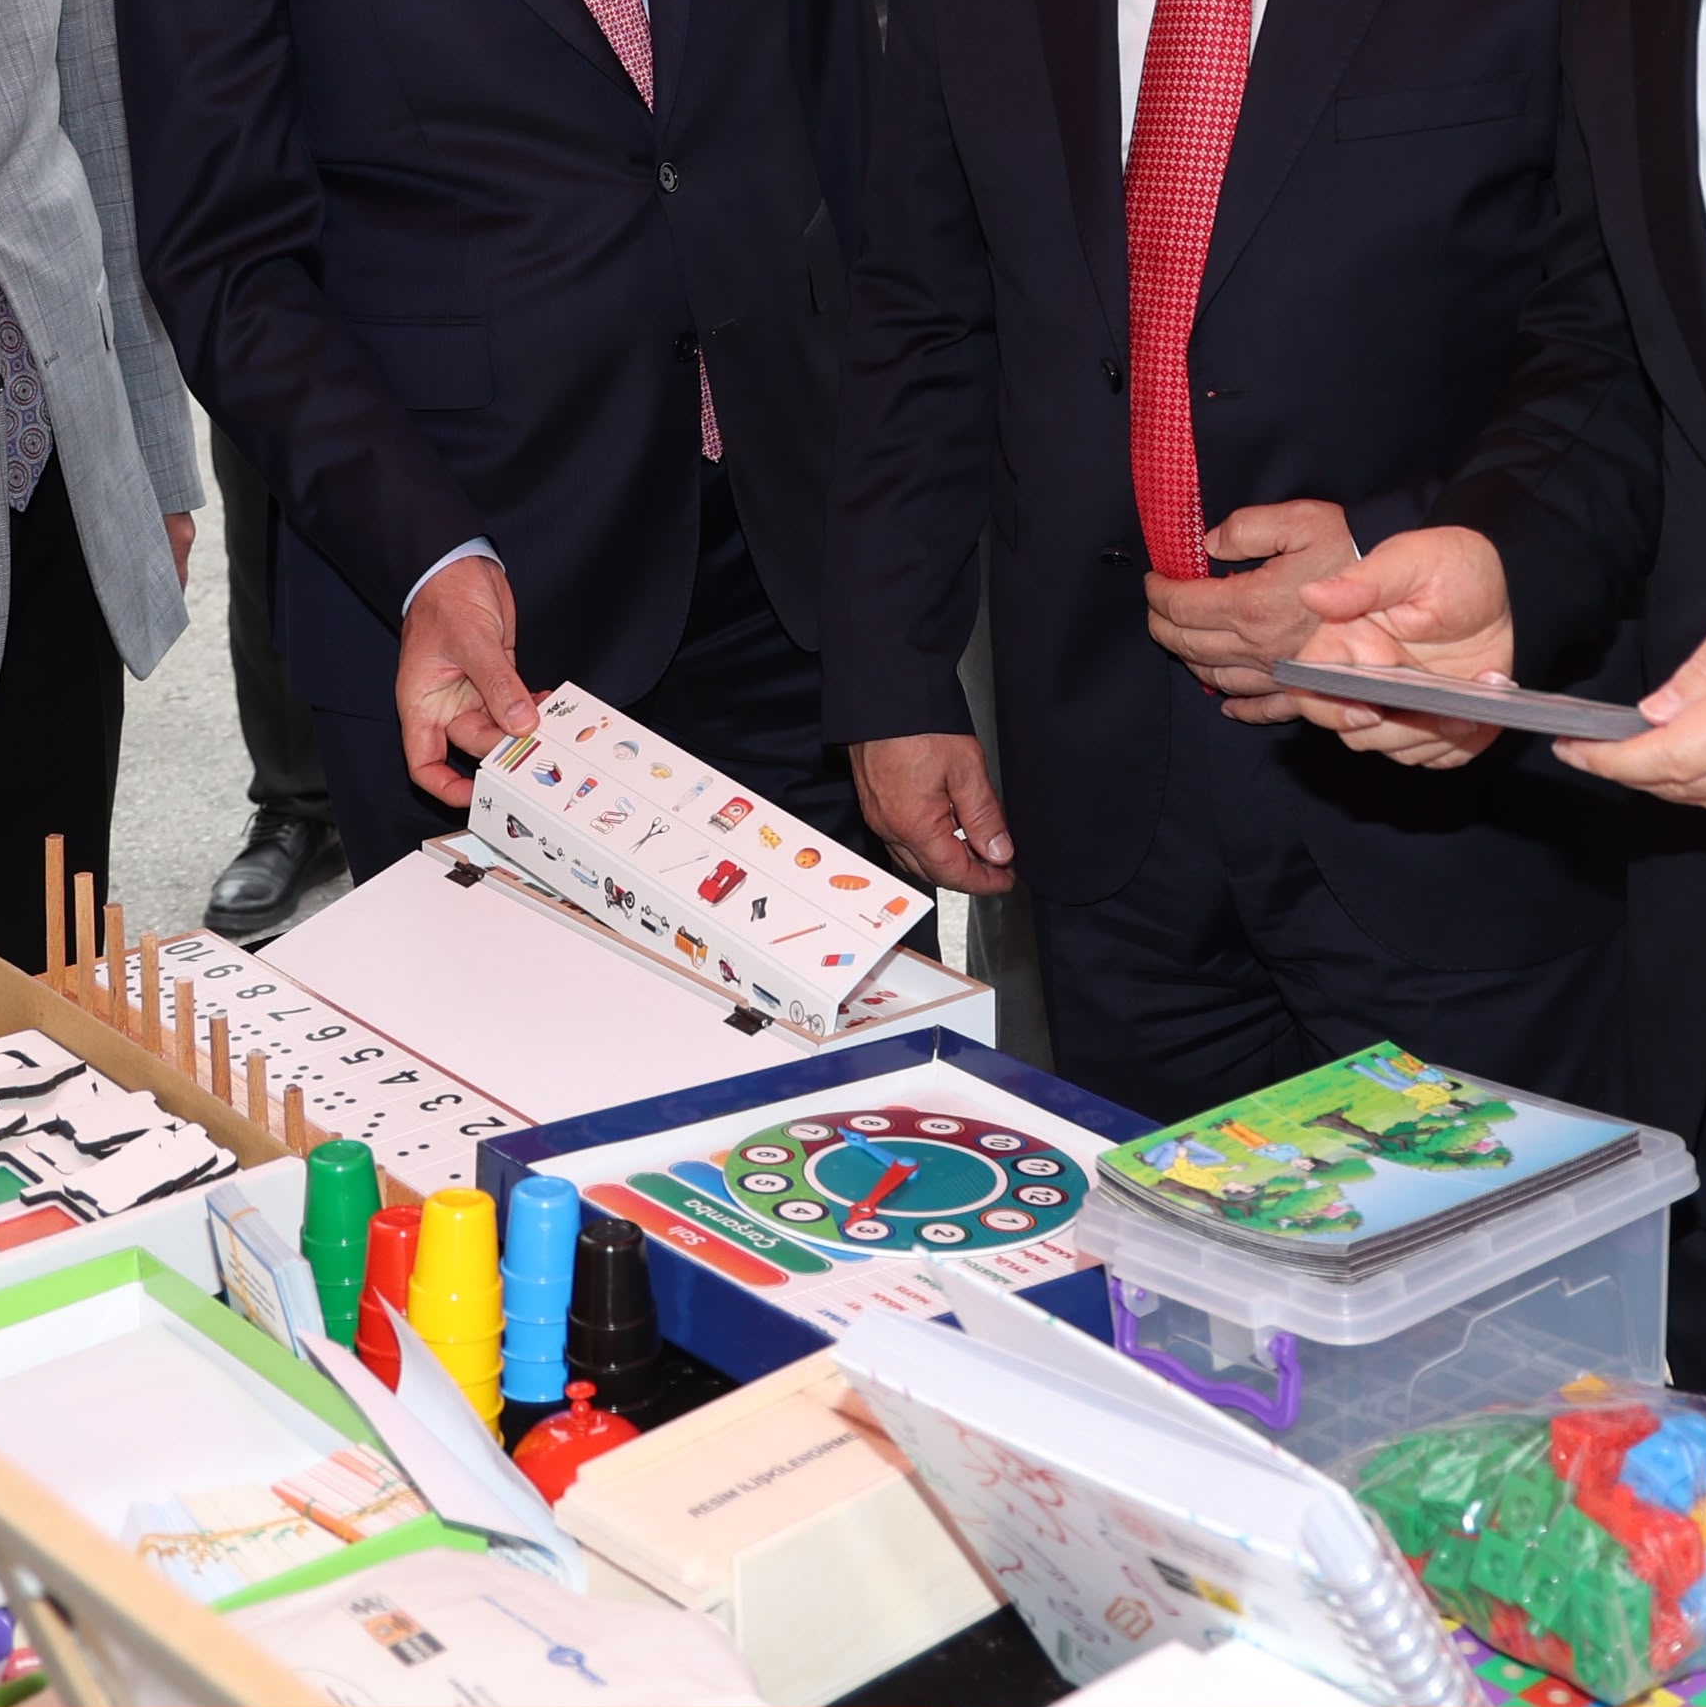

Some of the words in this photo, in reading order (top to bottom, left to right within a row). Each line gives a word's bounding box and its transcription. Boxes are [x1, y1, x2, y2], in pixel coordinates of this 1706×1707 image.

[164, 941, 215, 962] 10
[203, 964, 244, 979] 9
[236, 984, 277, 999] 8
[267, 1006, 312, 1022] 7
[305, 1025, 347, 1041] 6
[339, 1047, 384, 1065] 5
[378, 1069, 420, 1086] 4
[419, 1093, 463, 1112] 3
[459, 1116, 507, 1136] 2
[683, 1199, 781, 1249] Çarşamba
[667, 1225, 707, 1246] Salı
[816, 1309, 850, 1327] UBAT
[687, 1488, 740, 1518] RESİM
